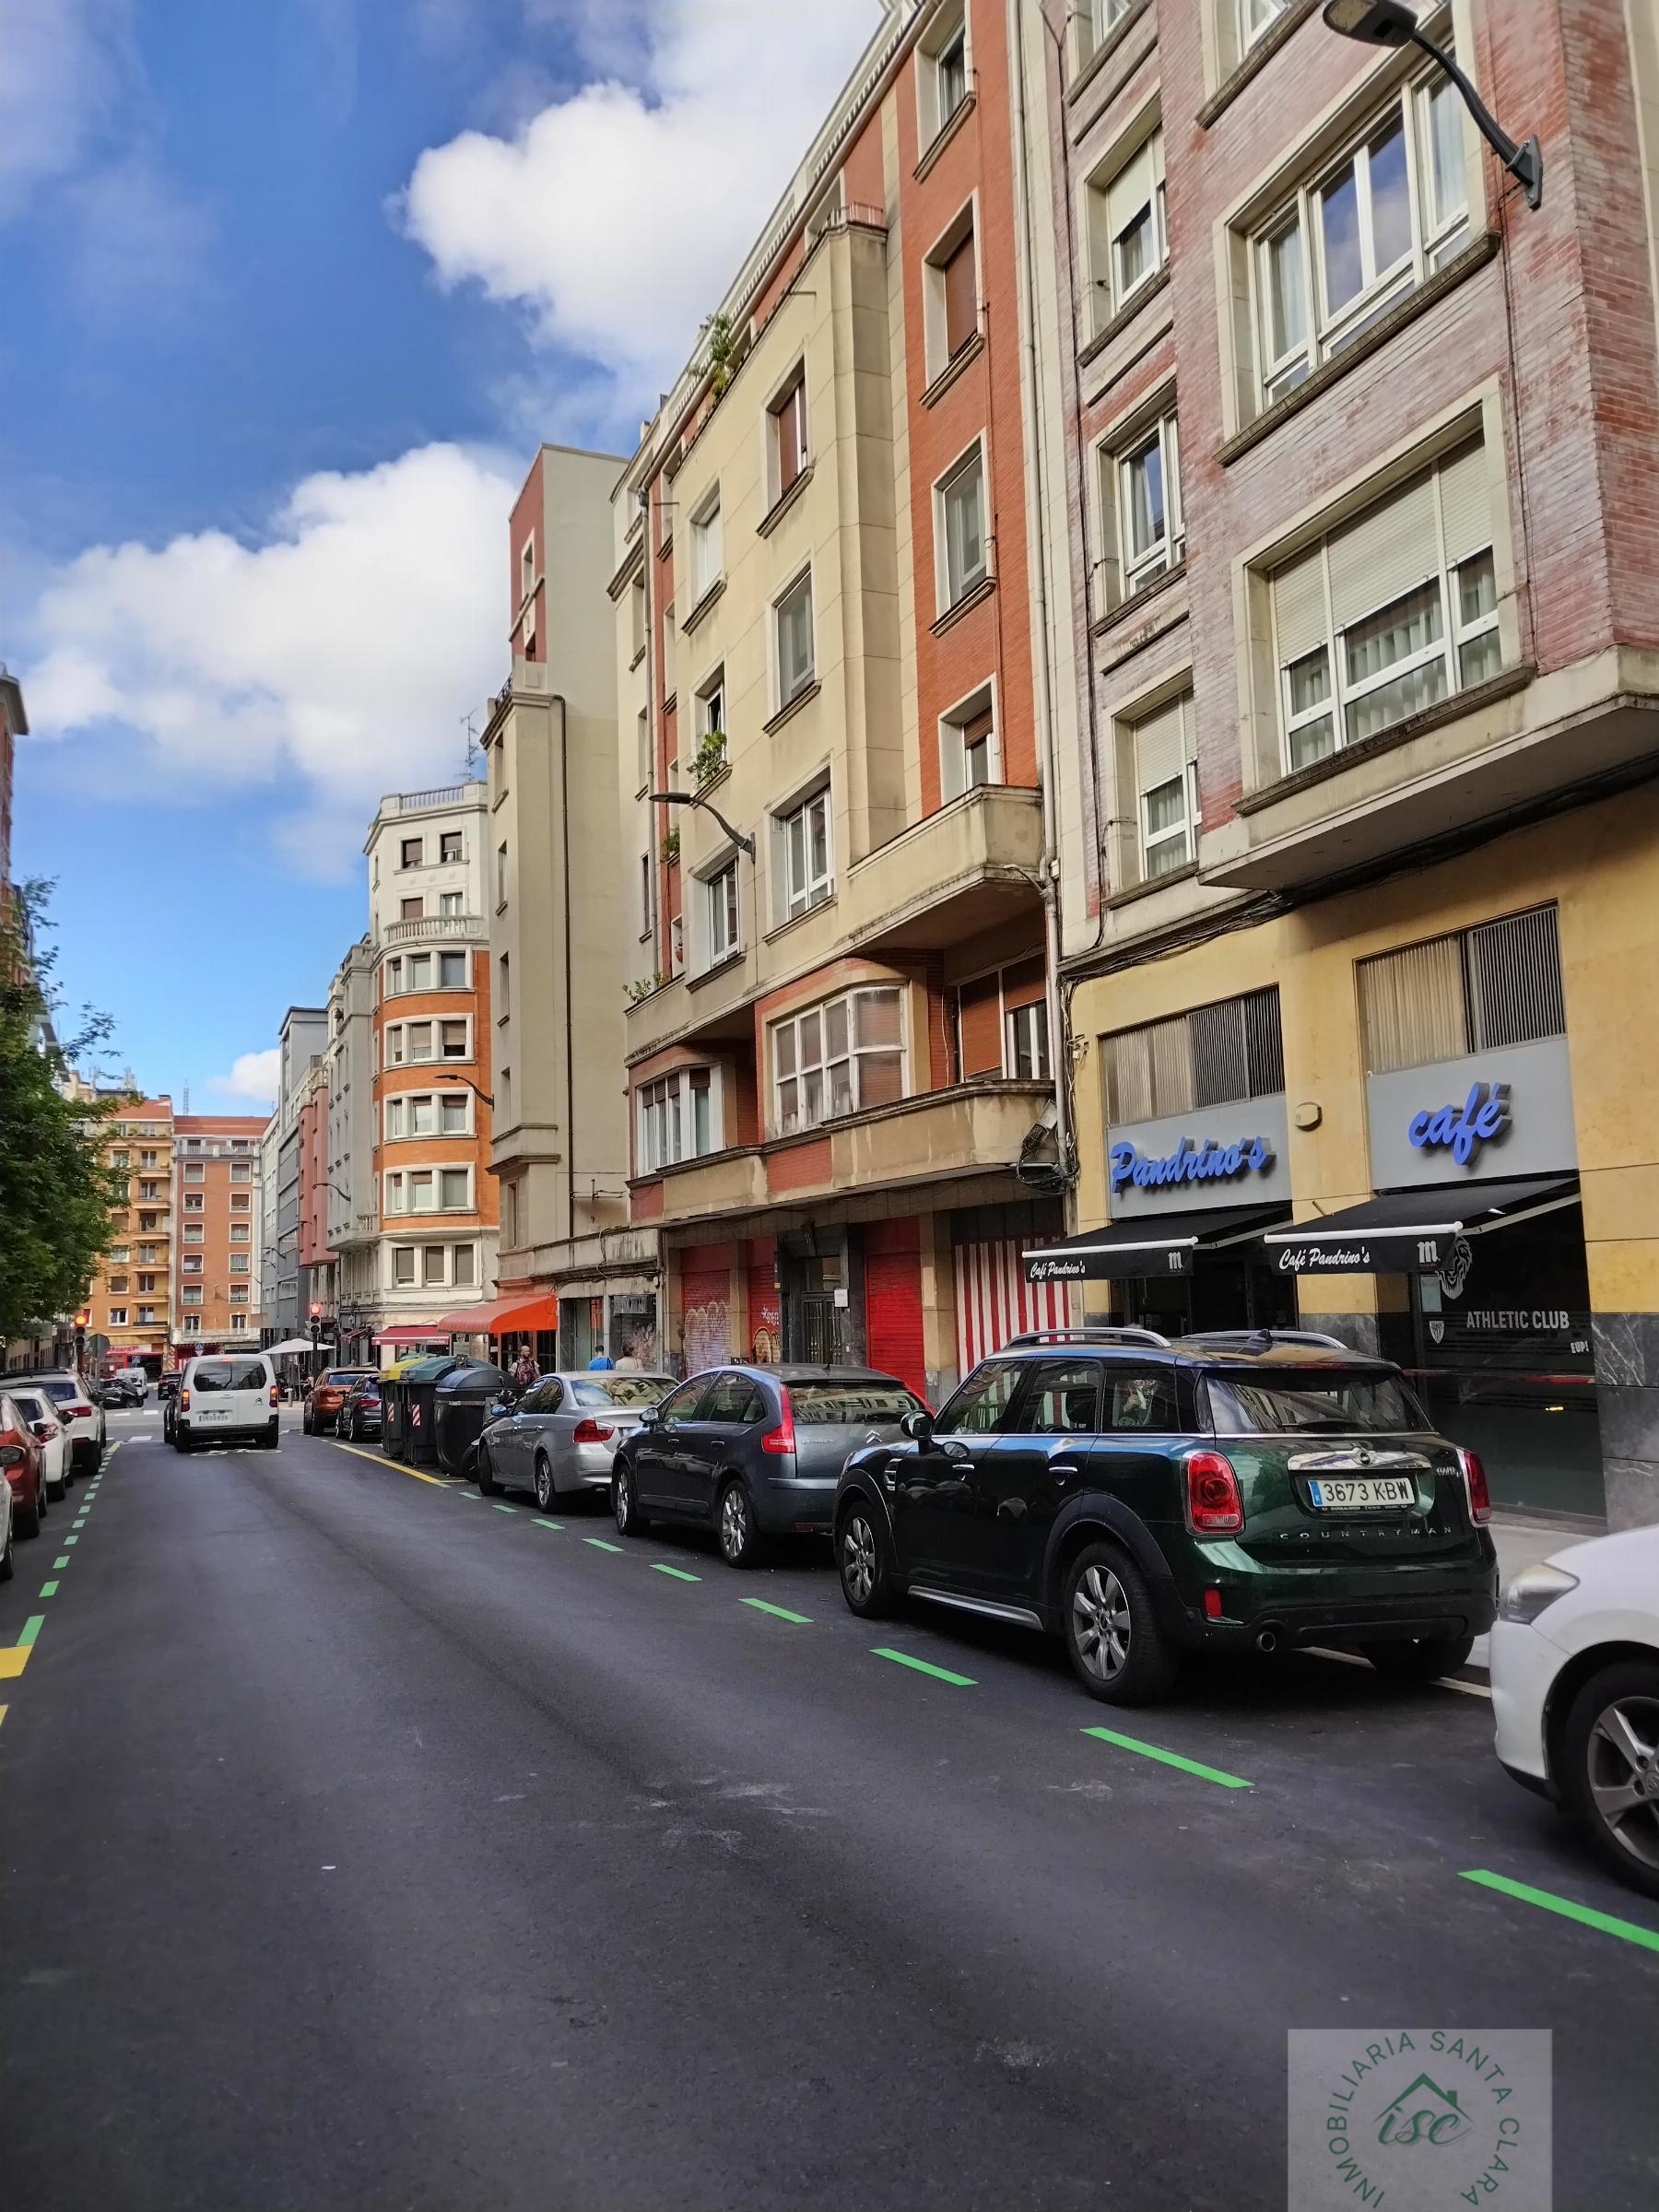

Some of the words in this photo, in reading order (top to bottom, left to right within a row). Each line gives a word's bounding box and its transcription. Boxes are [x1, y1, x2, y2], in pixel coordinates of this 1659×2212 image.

[1409, 1081, 1507, 1165] café
[1111, 1136, 1267, 1193] Pandrino's
[1048, 1261, 1086, 1276] Pandrino's
[1279, 1249, 1306, 1271] Café
[1309, 1246, 1371, 1266] Pandrino's
[1466, 1311, 1529, 1328] ATHLETIC
[1532, 1311, 1570, 1329] CLUB
[1323, 1482, 1369, 1502] 3673
[1373, 1481, 1409, 1501] KBW
[1279, 1526, 1452, 1540] COUNTRYMAN
